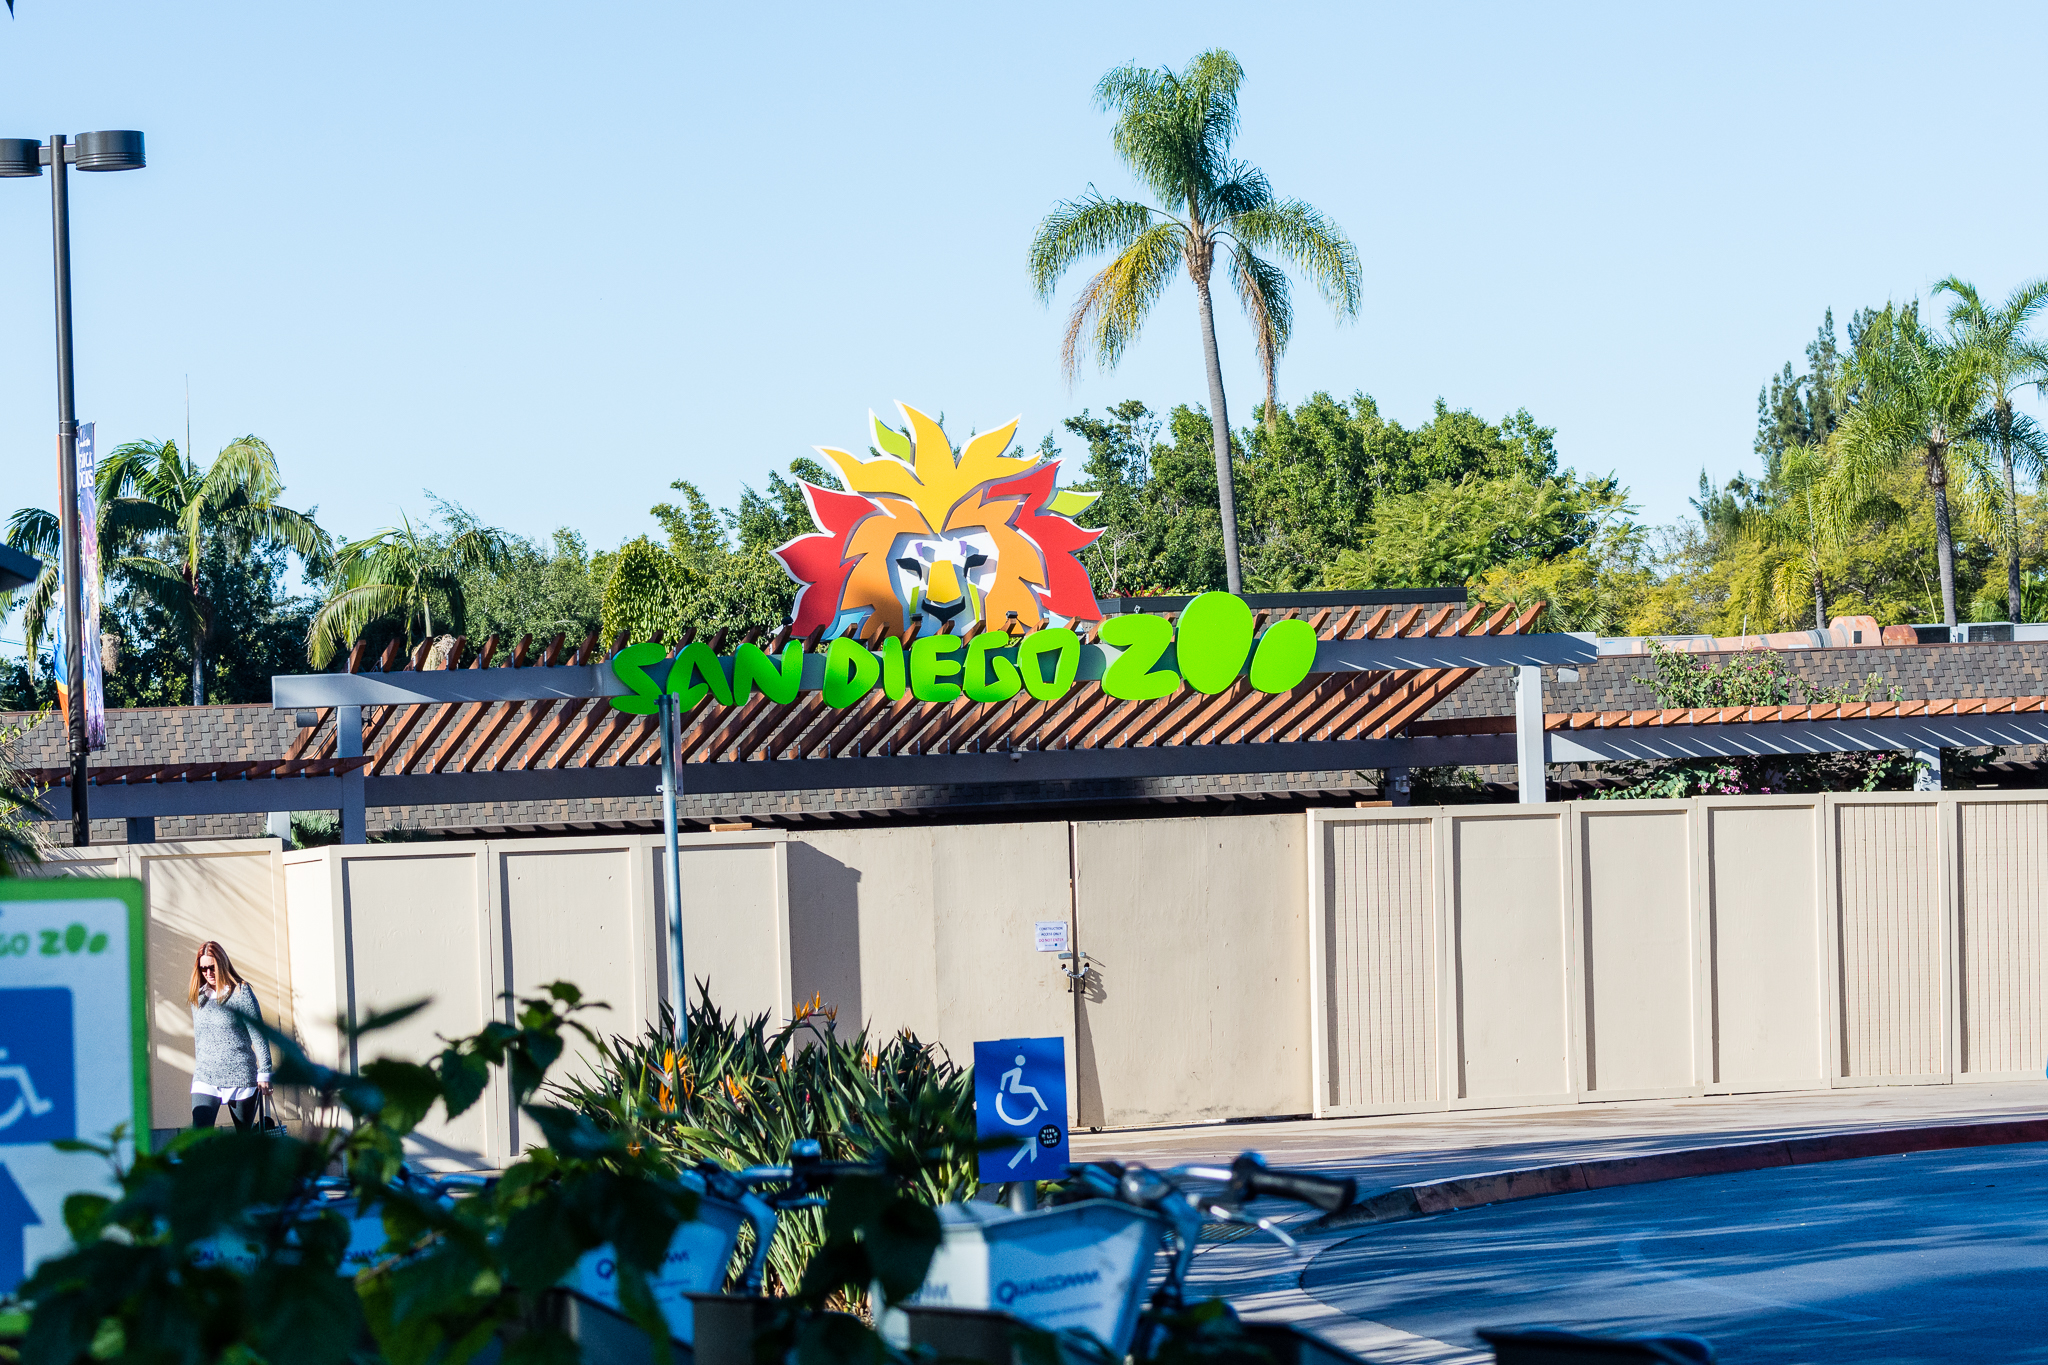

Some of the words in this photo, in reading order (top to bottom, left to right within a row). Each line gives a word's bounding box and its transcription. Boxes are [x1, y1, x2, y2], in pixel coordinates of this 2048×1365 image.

[609, 639, 803, 715] SAN
[823, 627, 1082, 709] DIEGO
[1098, 591, 1318, 701] ZOO
[39, 922, 109, 956] ZOO
